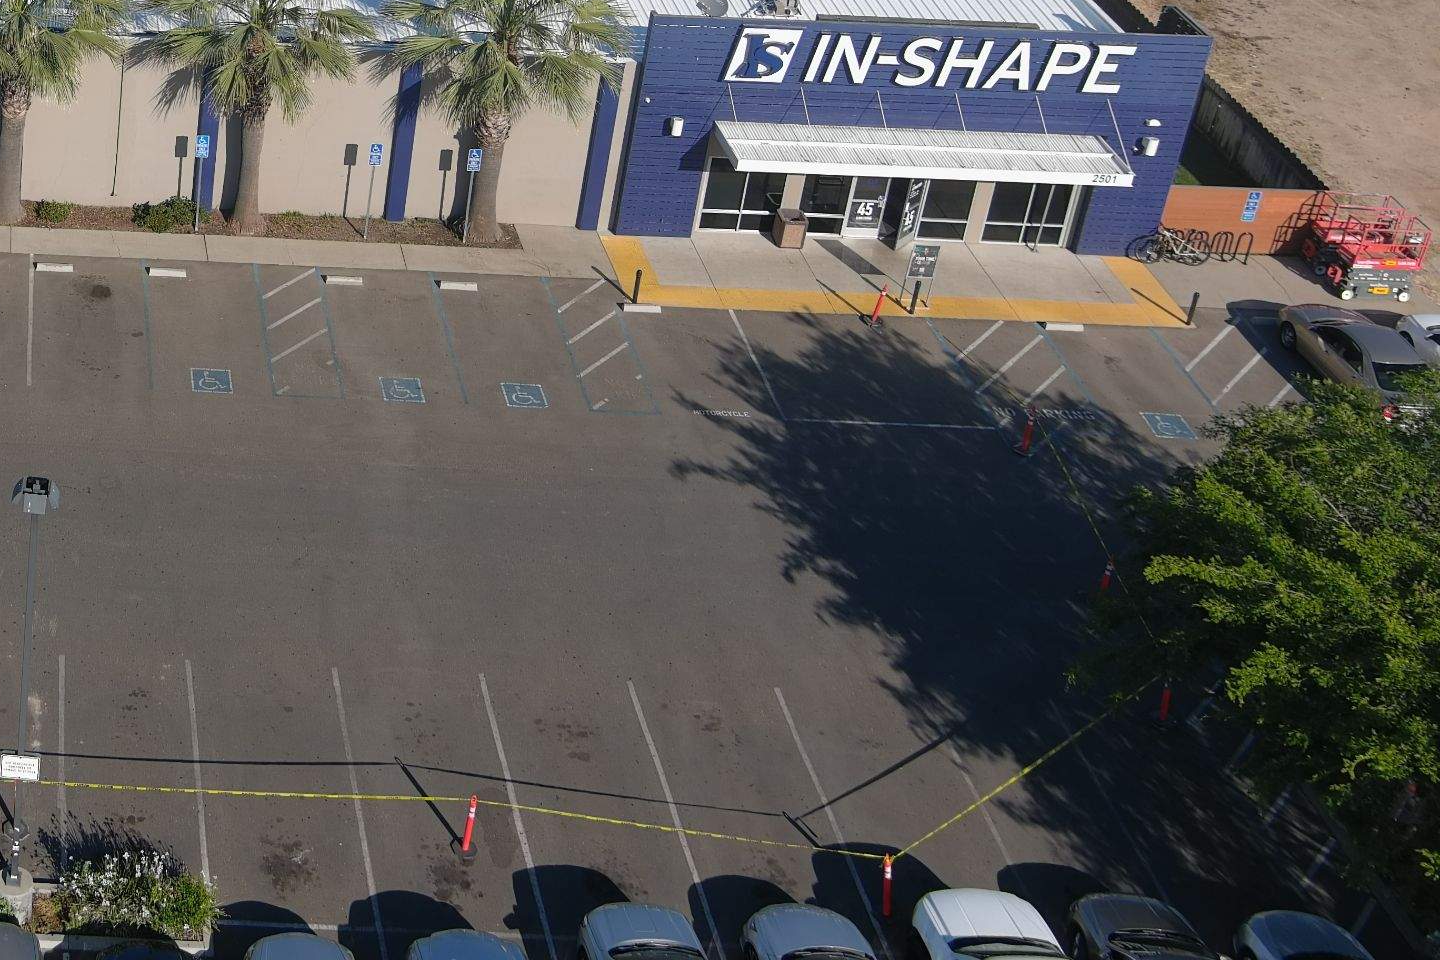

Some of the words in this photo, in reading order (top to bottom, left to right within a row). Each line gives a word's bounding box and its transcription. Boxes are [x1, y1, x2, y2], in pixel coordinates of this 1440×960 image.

[803, 34, 1138, 94] IN-SHAPE
[1092, 174, 1117, 184] 2501
[856, 202, 875, 216] 45
[693, 409, 752, 418] MOTORCYCLE
